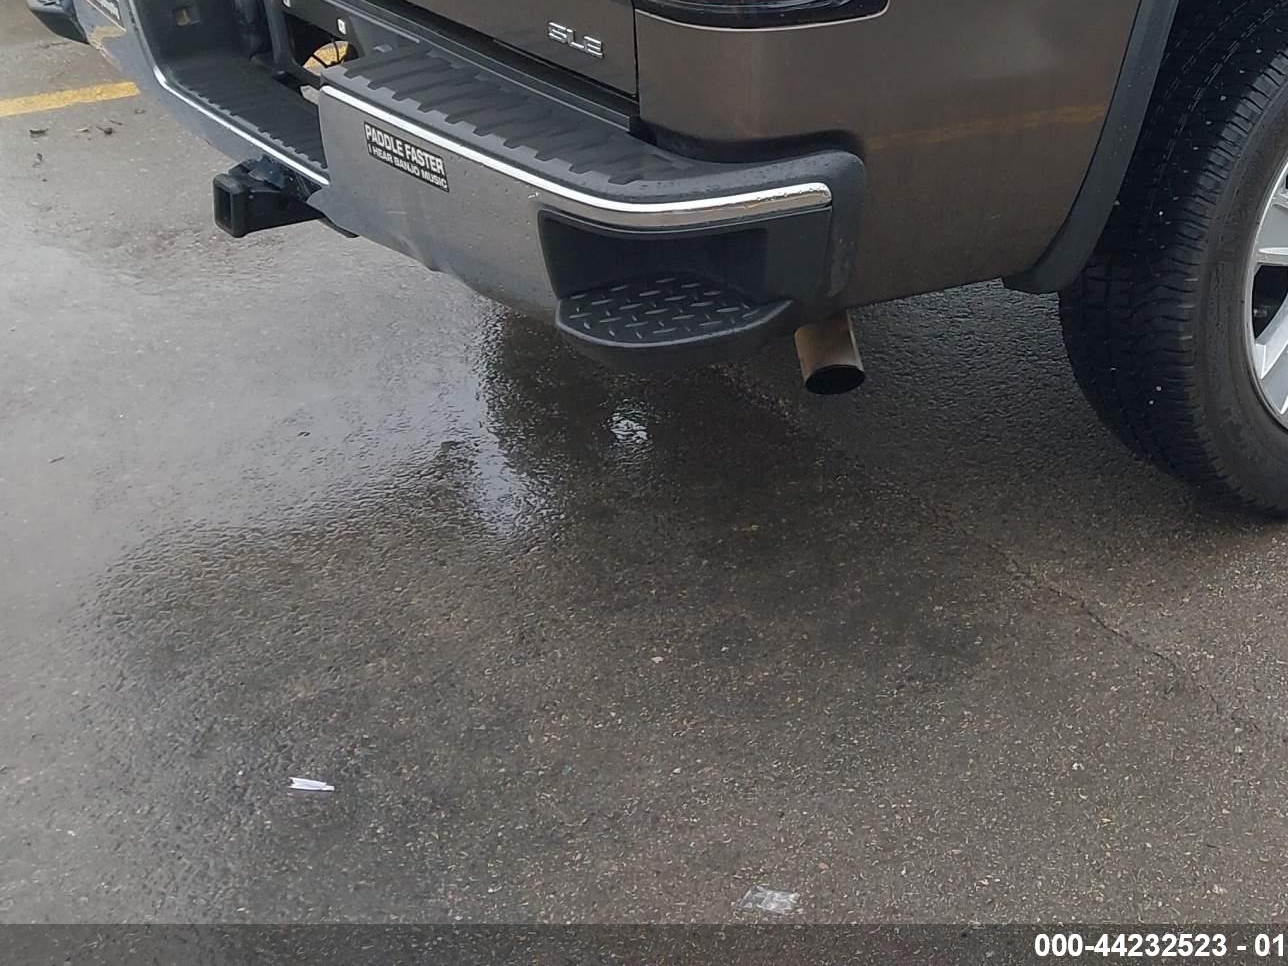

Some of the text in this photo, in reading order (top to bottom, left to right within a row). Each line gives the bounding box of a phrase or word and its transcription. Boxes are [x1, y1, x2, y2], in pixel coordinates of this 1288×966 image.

[547, 21, 605, 59] SLE
[364, 123, 446, 176] PADDLE FASTER
[372, 145, 394, 164] HEAR
[421, 169, 448, 189] MUSIC
